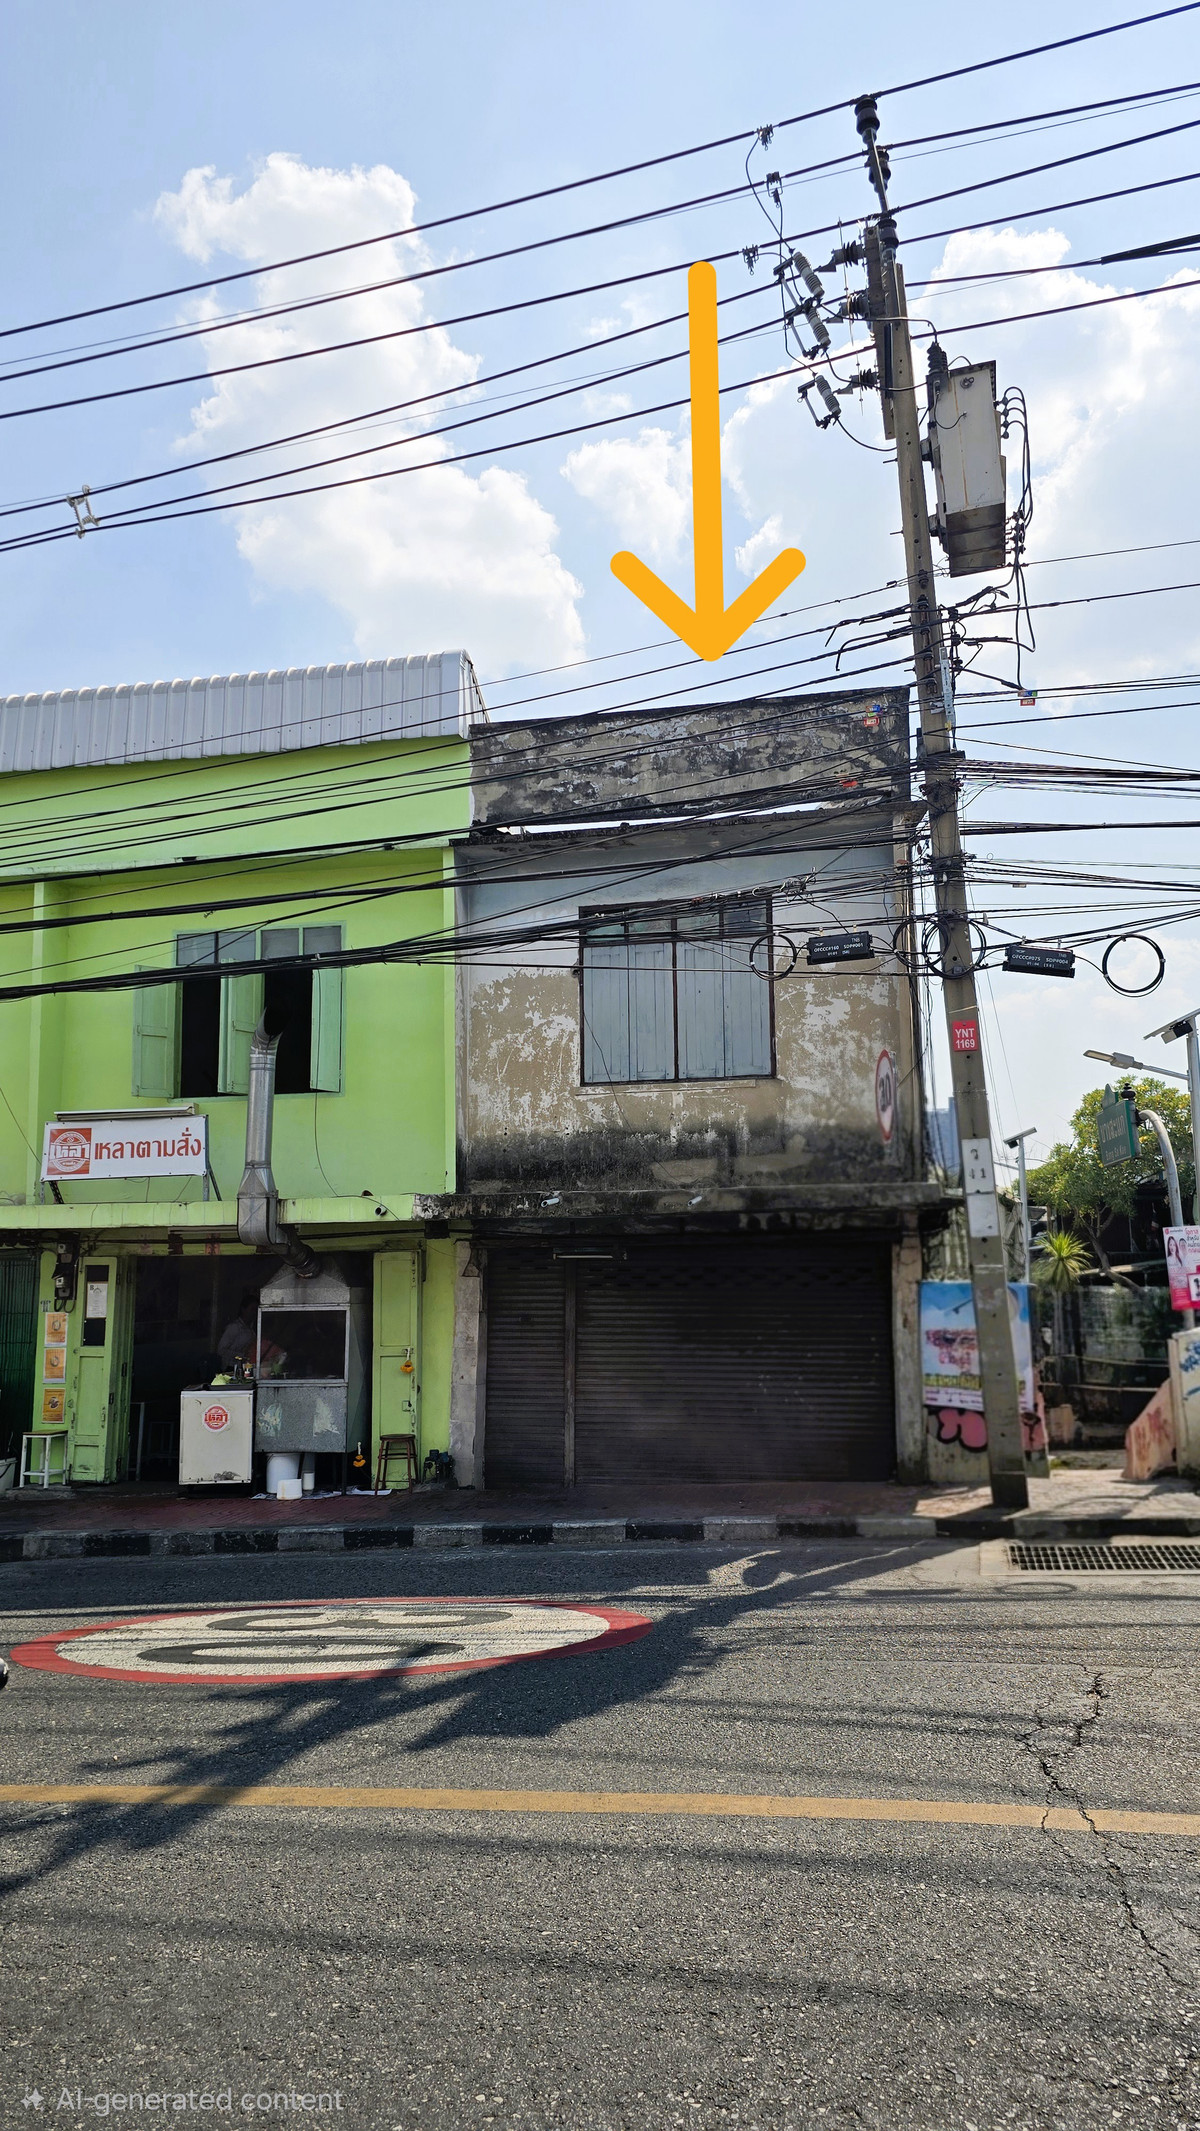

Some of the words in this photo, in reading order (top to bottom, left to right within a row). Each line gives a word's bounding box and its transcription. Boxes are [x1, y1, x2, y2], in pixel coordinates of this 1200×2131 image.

[955, 1028, 975, 1039] YNT
[955, 1039, 976, 1049] 1169
[879, 1071, 892, 1113] 30
[94, 1127, 202, 1160] เหลาตามสั่ง
